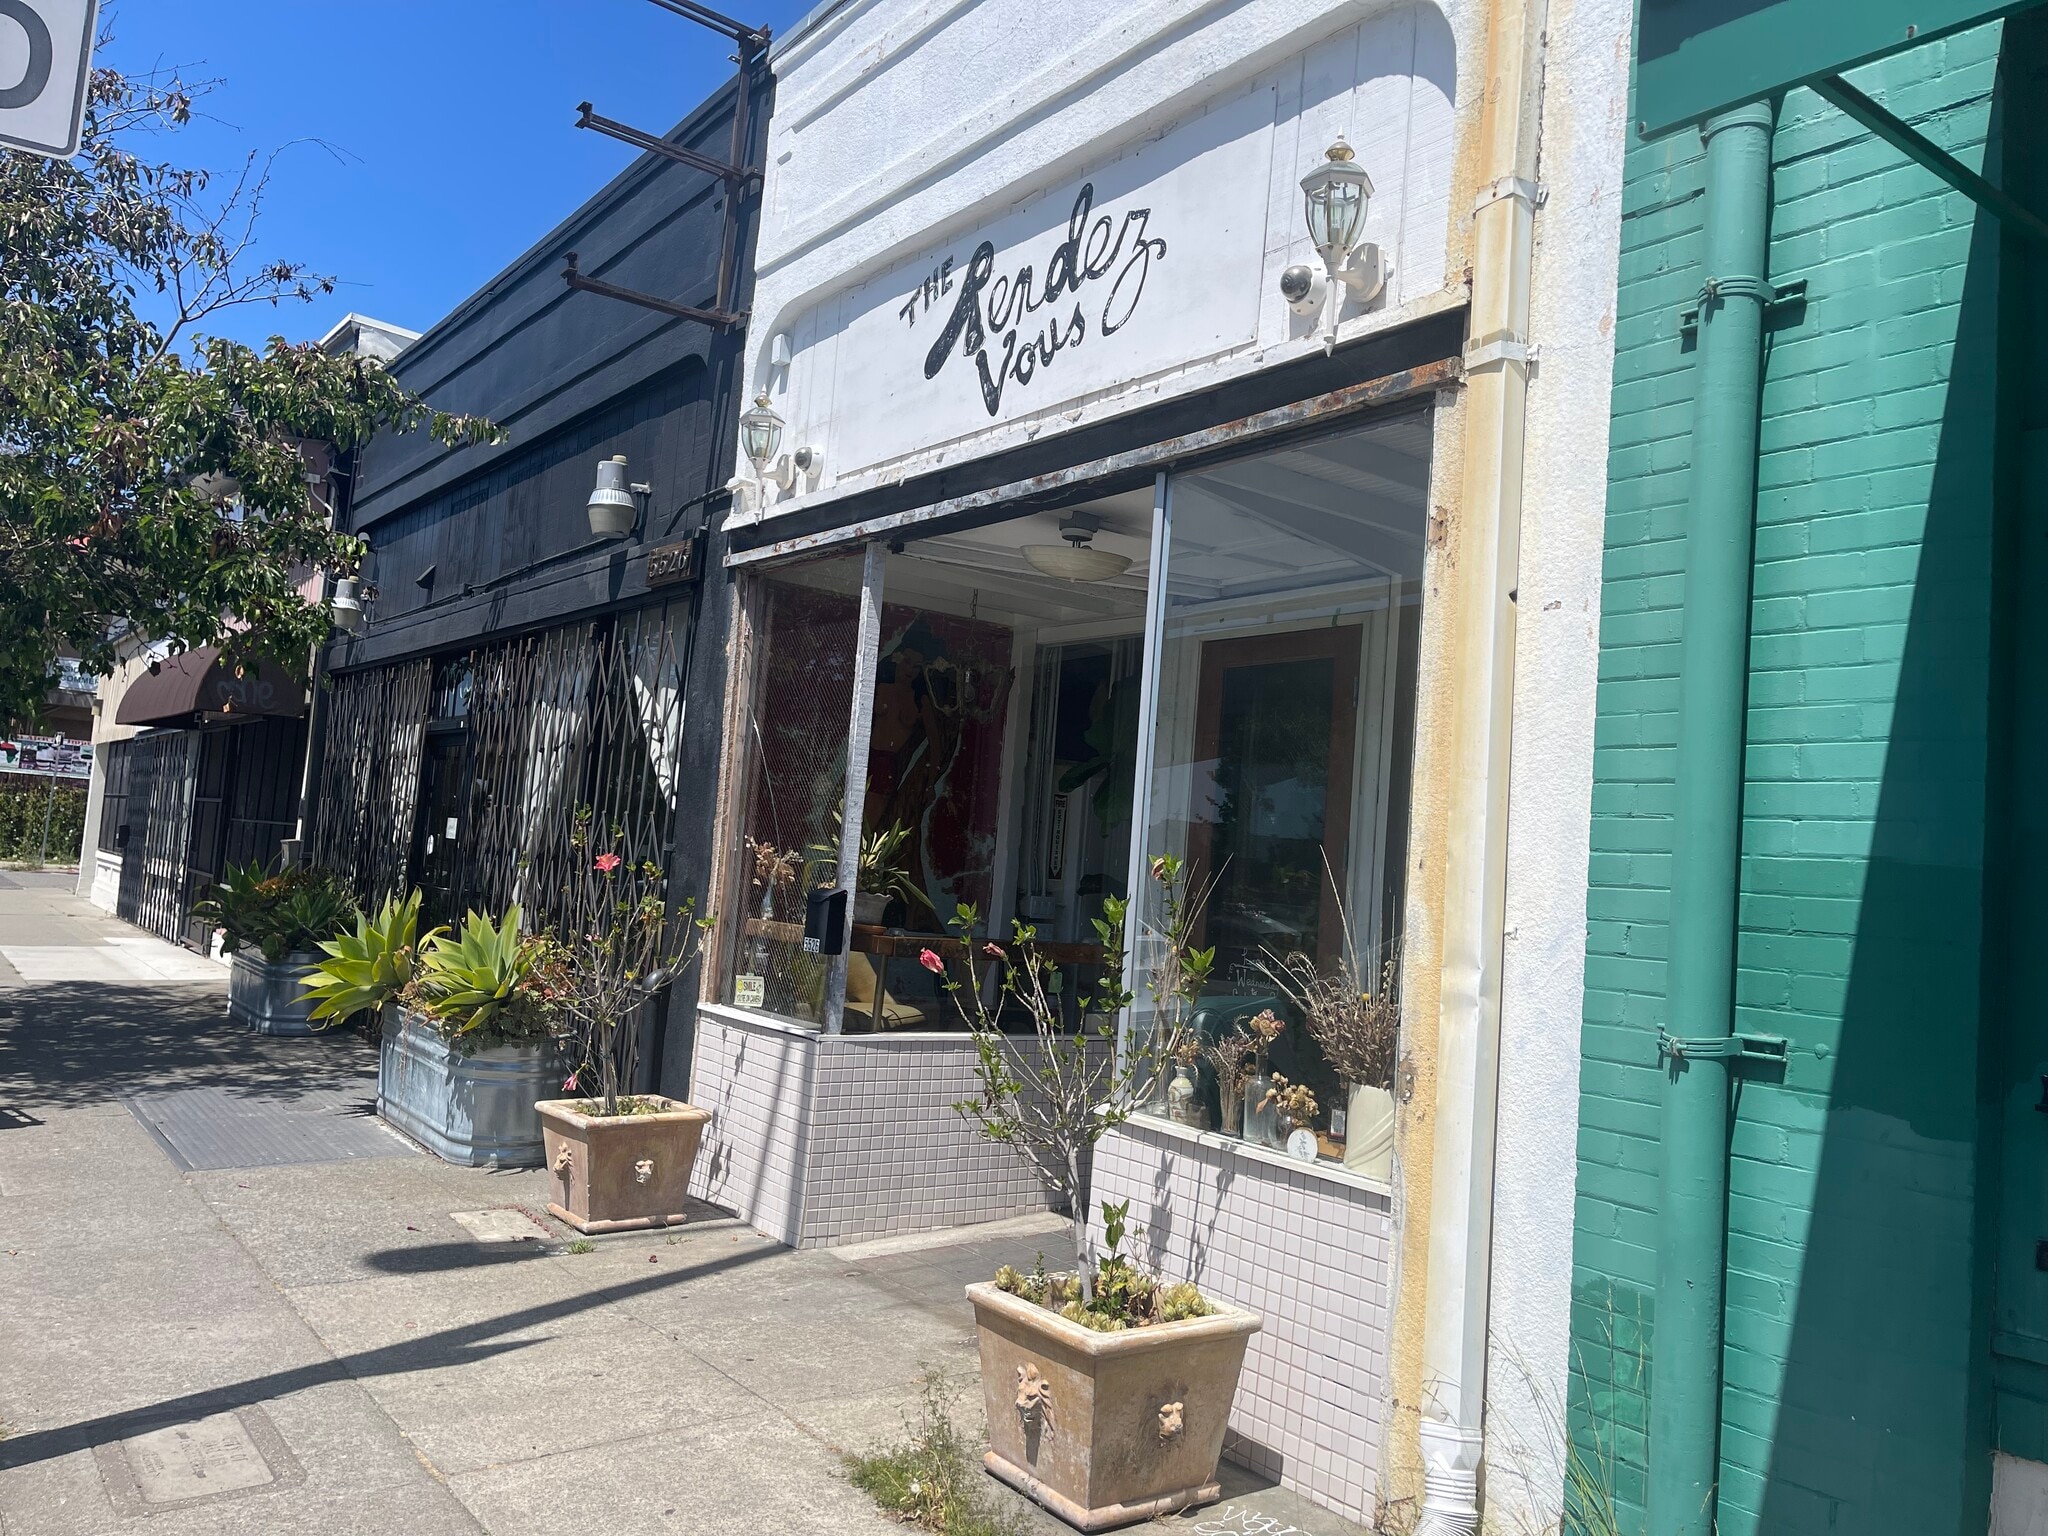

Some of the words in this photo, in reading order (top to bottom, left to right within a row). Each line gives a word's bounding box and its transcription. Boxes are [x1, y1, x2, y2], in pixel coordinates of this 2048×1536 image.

[899, 254, 953, 329] THE
[924, 182, 1167, 380] Rendez
[975, 301, 1086, 416] Vous
[649, 548, 689, 578] 5526
[804, 938, 819, 952] 5526
[743, 981, 756, 992] SMILE
